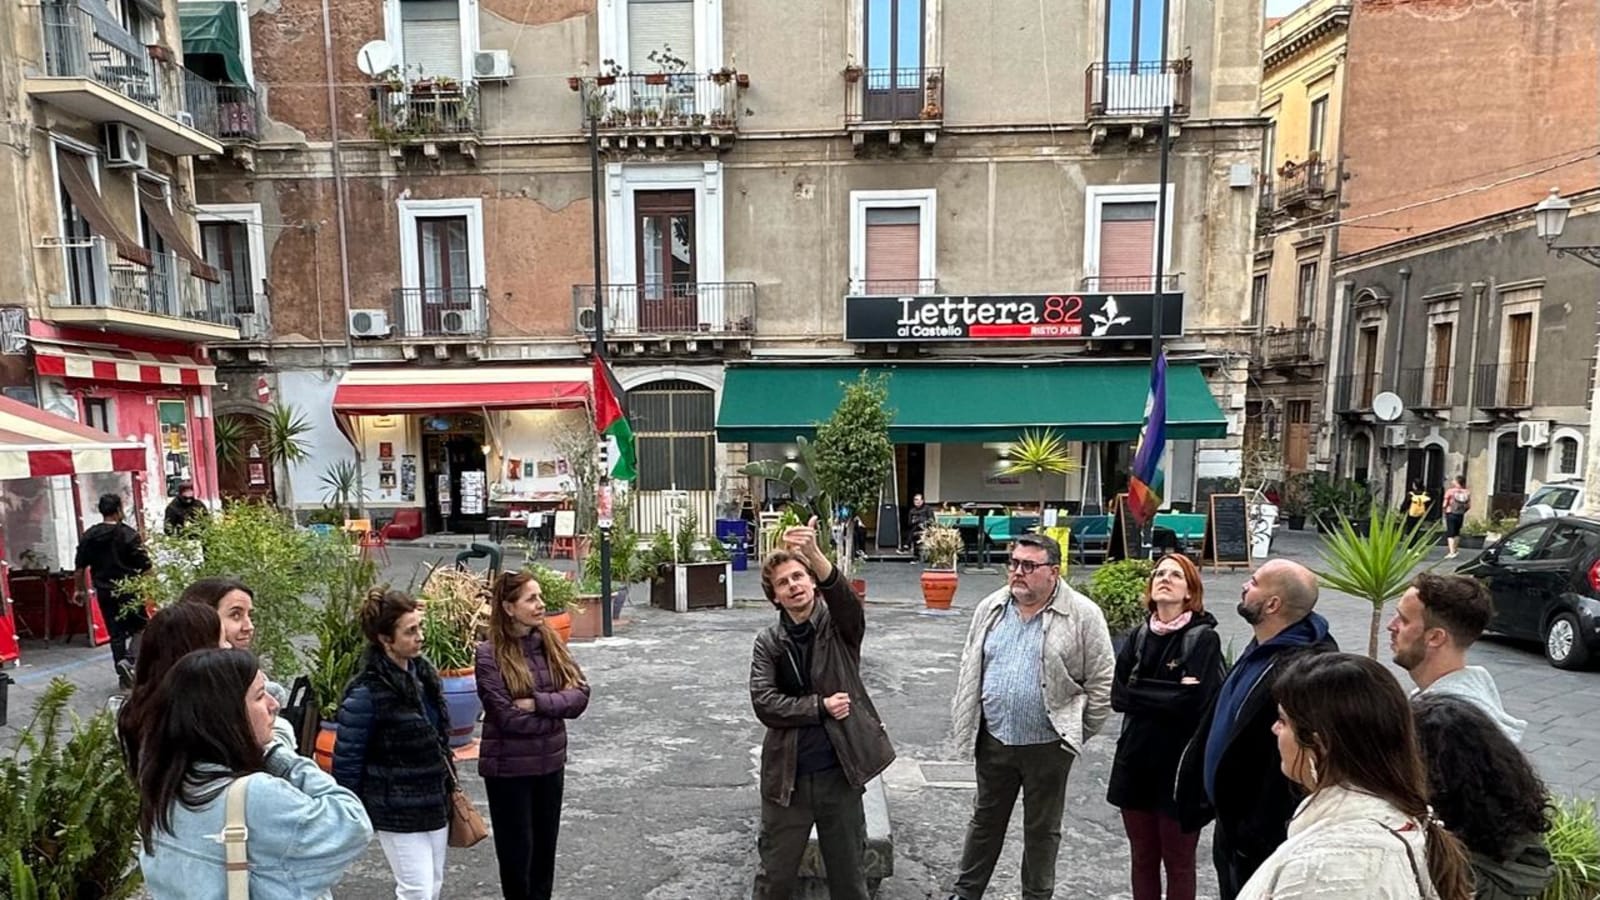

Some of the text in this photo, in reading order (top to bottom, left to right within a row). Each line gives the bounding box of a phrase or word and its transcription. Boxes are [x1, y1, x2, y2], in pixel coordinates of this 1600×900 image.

[897, 296, 1082, 325] Lettera 82
[897, 325, 963, 337] al Castello
[1031, 325, 1058, 336] RISTO
